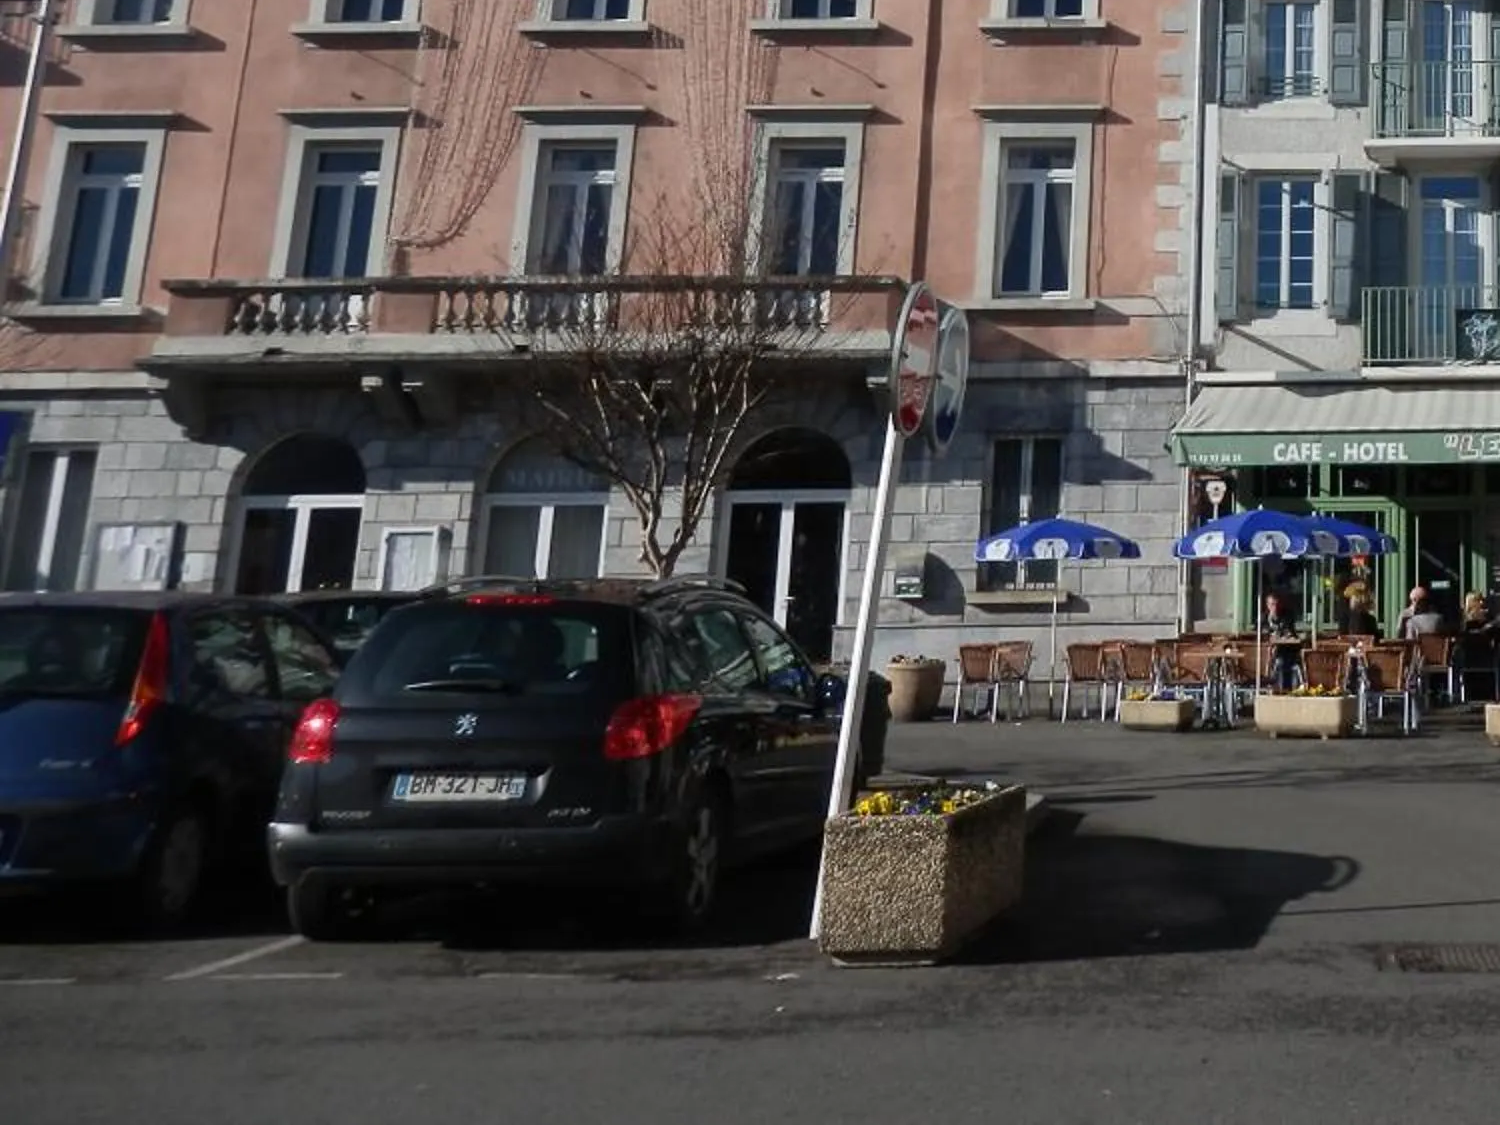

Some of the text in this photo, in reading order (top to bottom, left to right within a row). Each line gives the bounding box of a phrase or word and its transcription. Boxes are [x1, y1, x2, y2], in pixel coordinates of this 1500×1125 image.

[1272, 442, 1323, 461] CAFE
[1343, 442, 1409, 461] HOTEL
[410, 775, 512, 794] BM-321-JH
